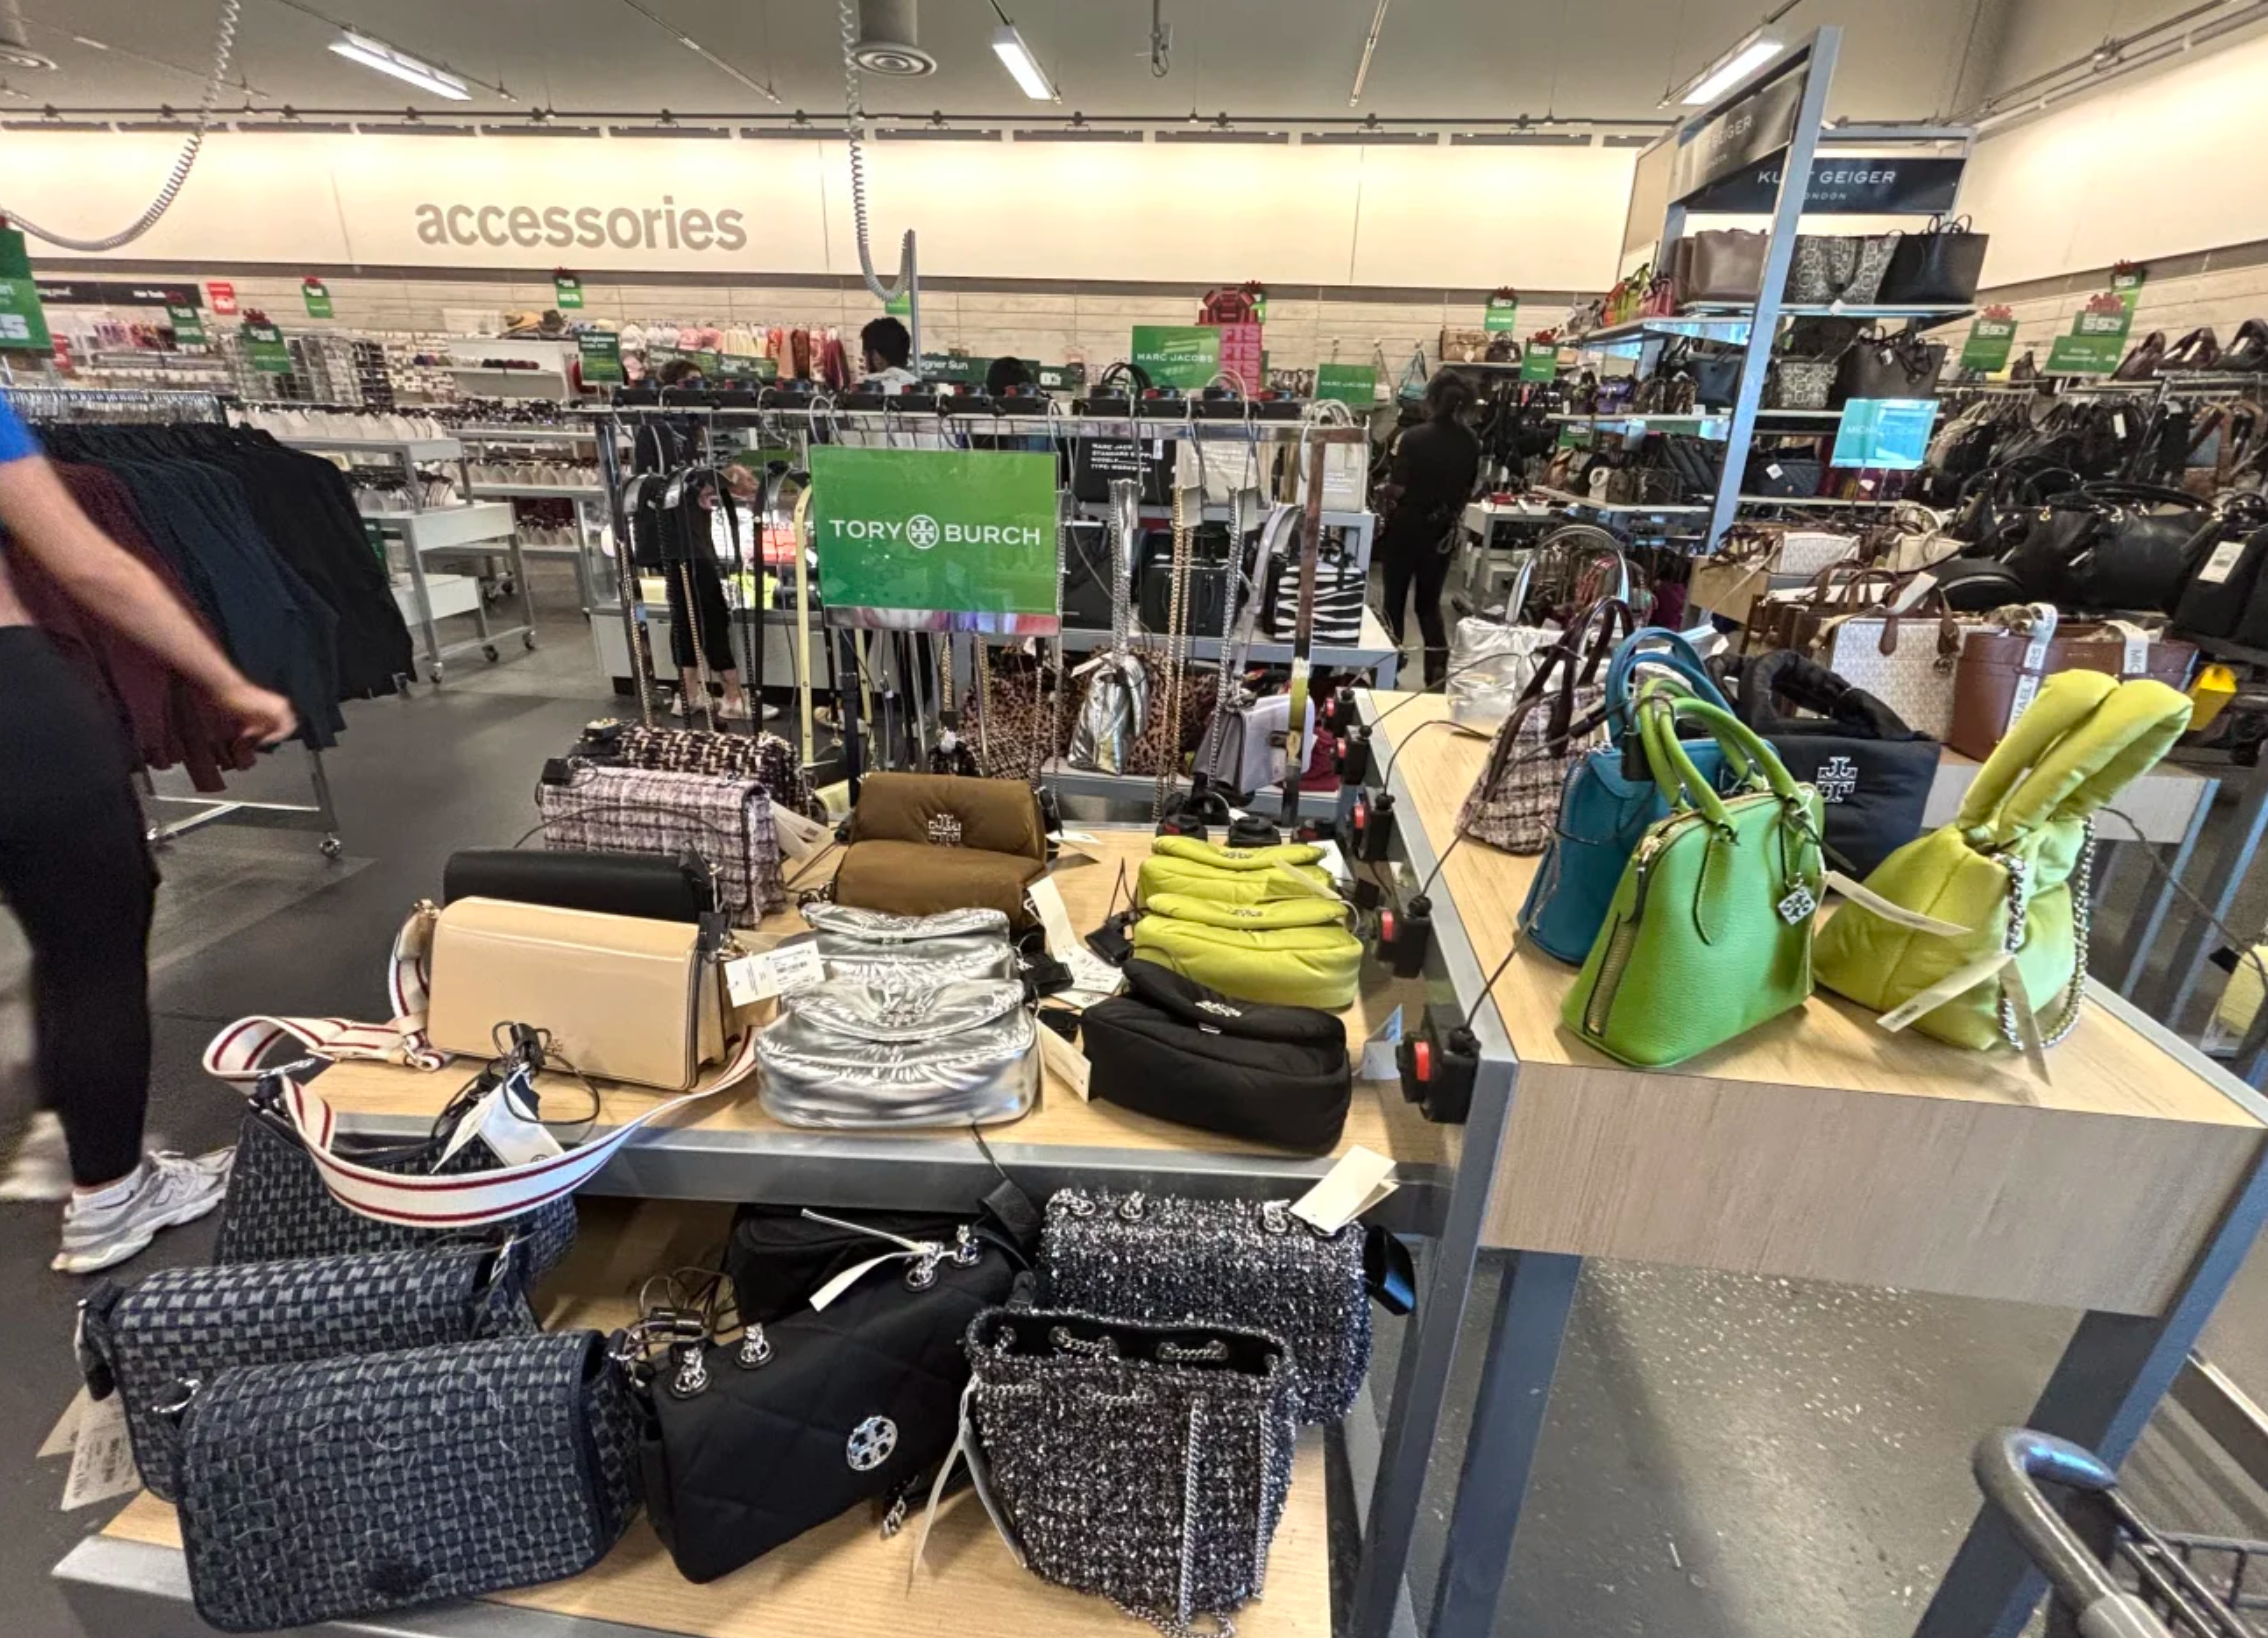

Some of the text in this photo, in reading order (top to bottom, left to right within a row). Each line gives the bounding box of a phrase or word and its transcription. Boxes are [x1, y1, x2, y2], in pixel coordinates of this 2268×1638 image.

[1819, 171, 1897, 184] GEIGER
[1803, 192, 1847, 200] ONDON
[415, 195, 748, 251] accessories
[1222, 326, 1260, 342] FTS
[1137, 353, 1214, 363] MARC JACOBS
[1222, 343, 1260, 360] FTS
[829, 519, 1041, 545] TORY BURCH
